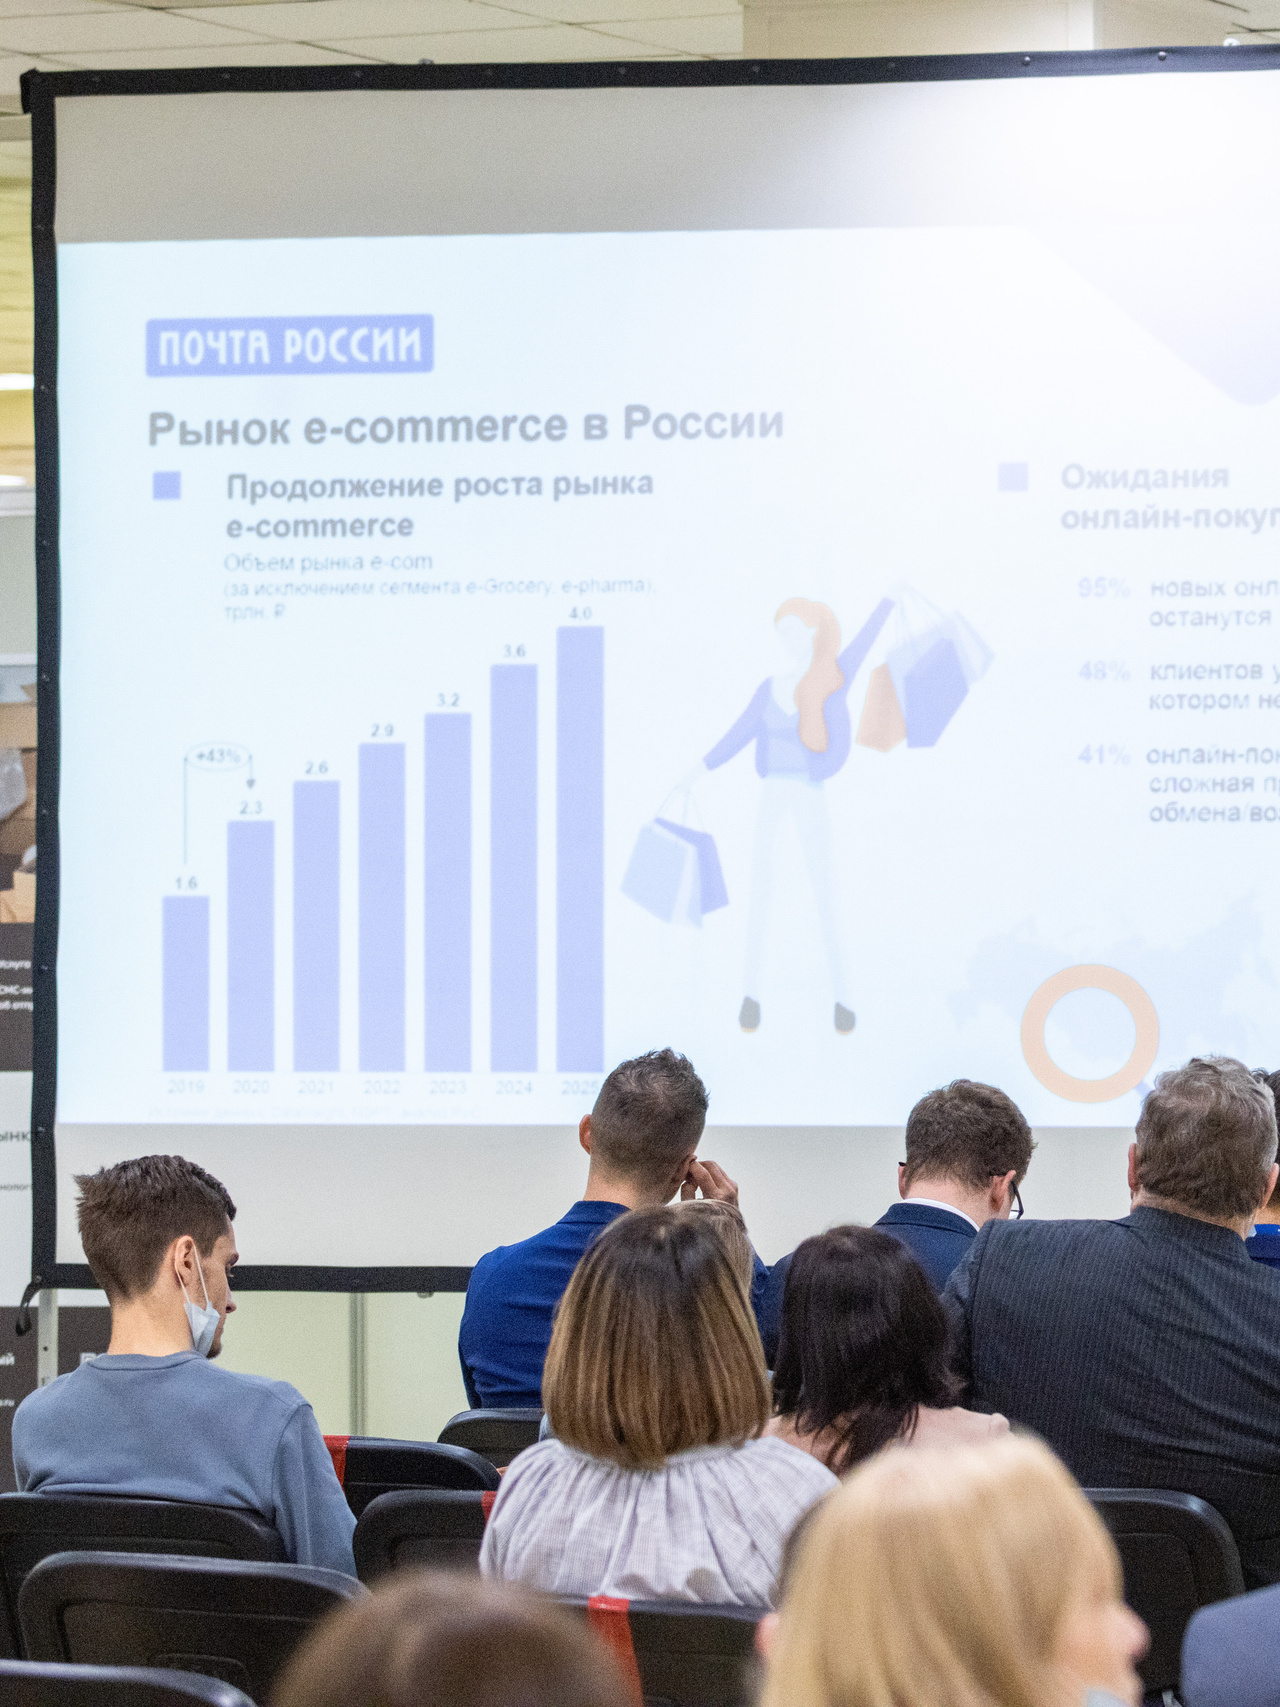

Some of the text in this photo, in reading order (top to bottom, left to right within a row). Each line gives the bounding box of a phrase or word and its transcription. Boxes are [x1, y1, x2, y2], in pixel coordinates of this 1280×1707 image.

[159, 327, 421, 365] ПОЧТА РОССИИ
[149, 404, 782, 446] Рынок e-commerce в России
[227, 474, 653, 502] Продолжение роста рынка
[1061, 464, 1229, 492] Ожидания
[226, 516, 414, 538] e-commerce
[224, 552, 432, 574] Объем рынка e-com
[254, 581, 374, 596] исключением
[379, 578, 460, 597] сегмента
[1078, 576, 1130, 598] 95%
[1151, 578, 1226, 598] новых
[1150, 608, 1272, 630] останутся
[1078, 660, 1130, 681] 48%
[1150, 662, 1262, 681] клиентов
[1150, 692, 1250, 712] котором
[1078, 744, 1130, 765] 41%
[1150, 775, 1254, 794] сложная
